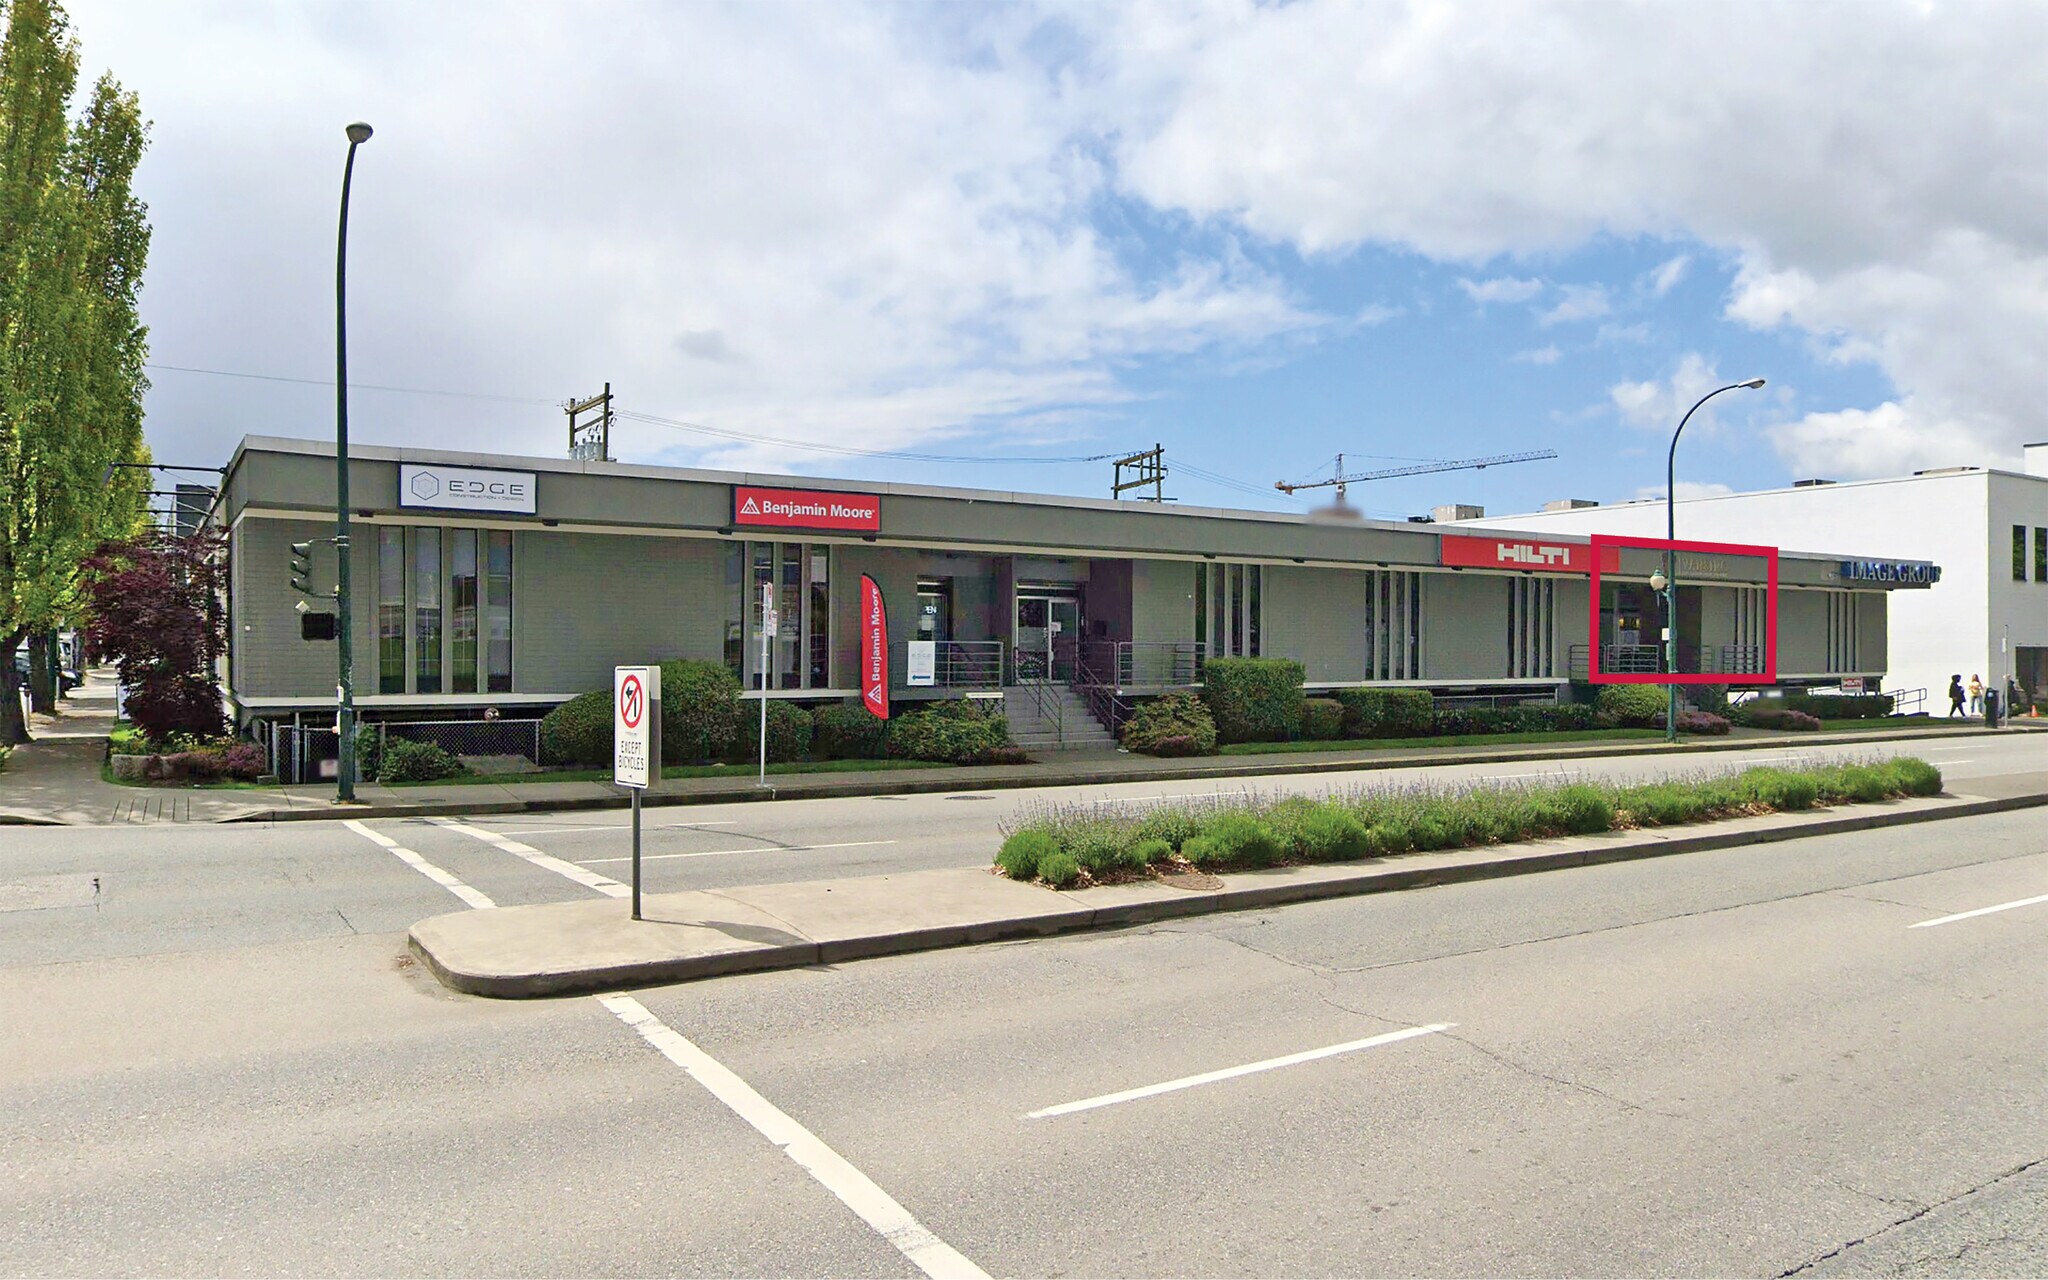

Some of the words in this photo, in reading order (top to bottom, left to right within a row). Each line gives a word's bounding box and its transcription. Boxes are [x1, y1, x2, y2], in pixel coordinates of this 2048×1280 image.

[449, 480, 524, 496] EDGE
[763, 500, 827, 518] Benjamin
[830, 504, 873, 518] Moore
[1497, 543, 1569, 565] HILTI
[1850, 561, 1895, 581] IMAGE
[871, 588, 881, 625] Moore
[871, 628, 882, 681] Benjamin
[621, 740, 641, 755] EXCEPT
[619, 754, 644, 771] BICYCLES
